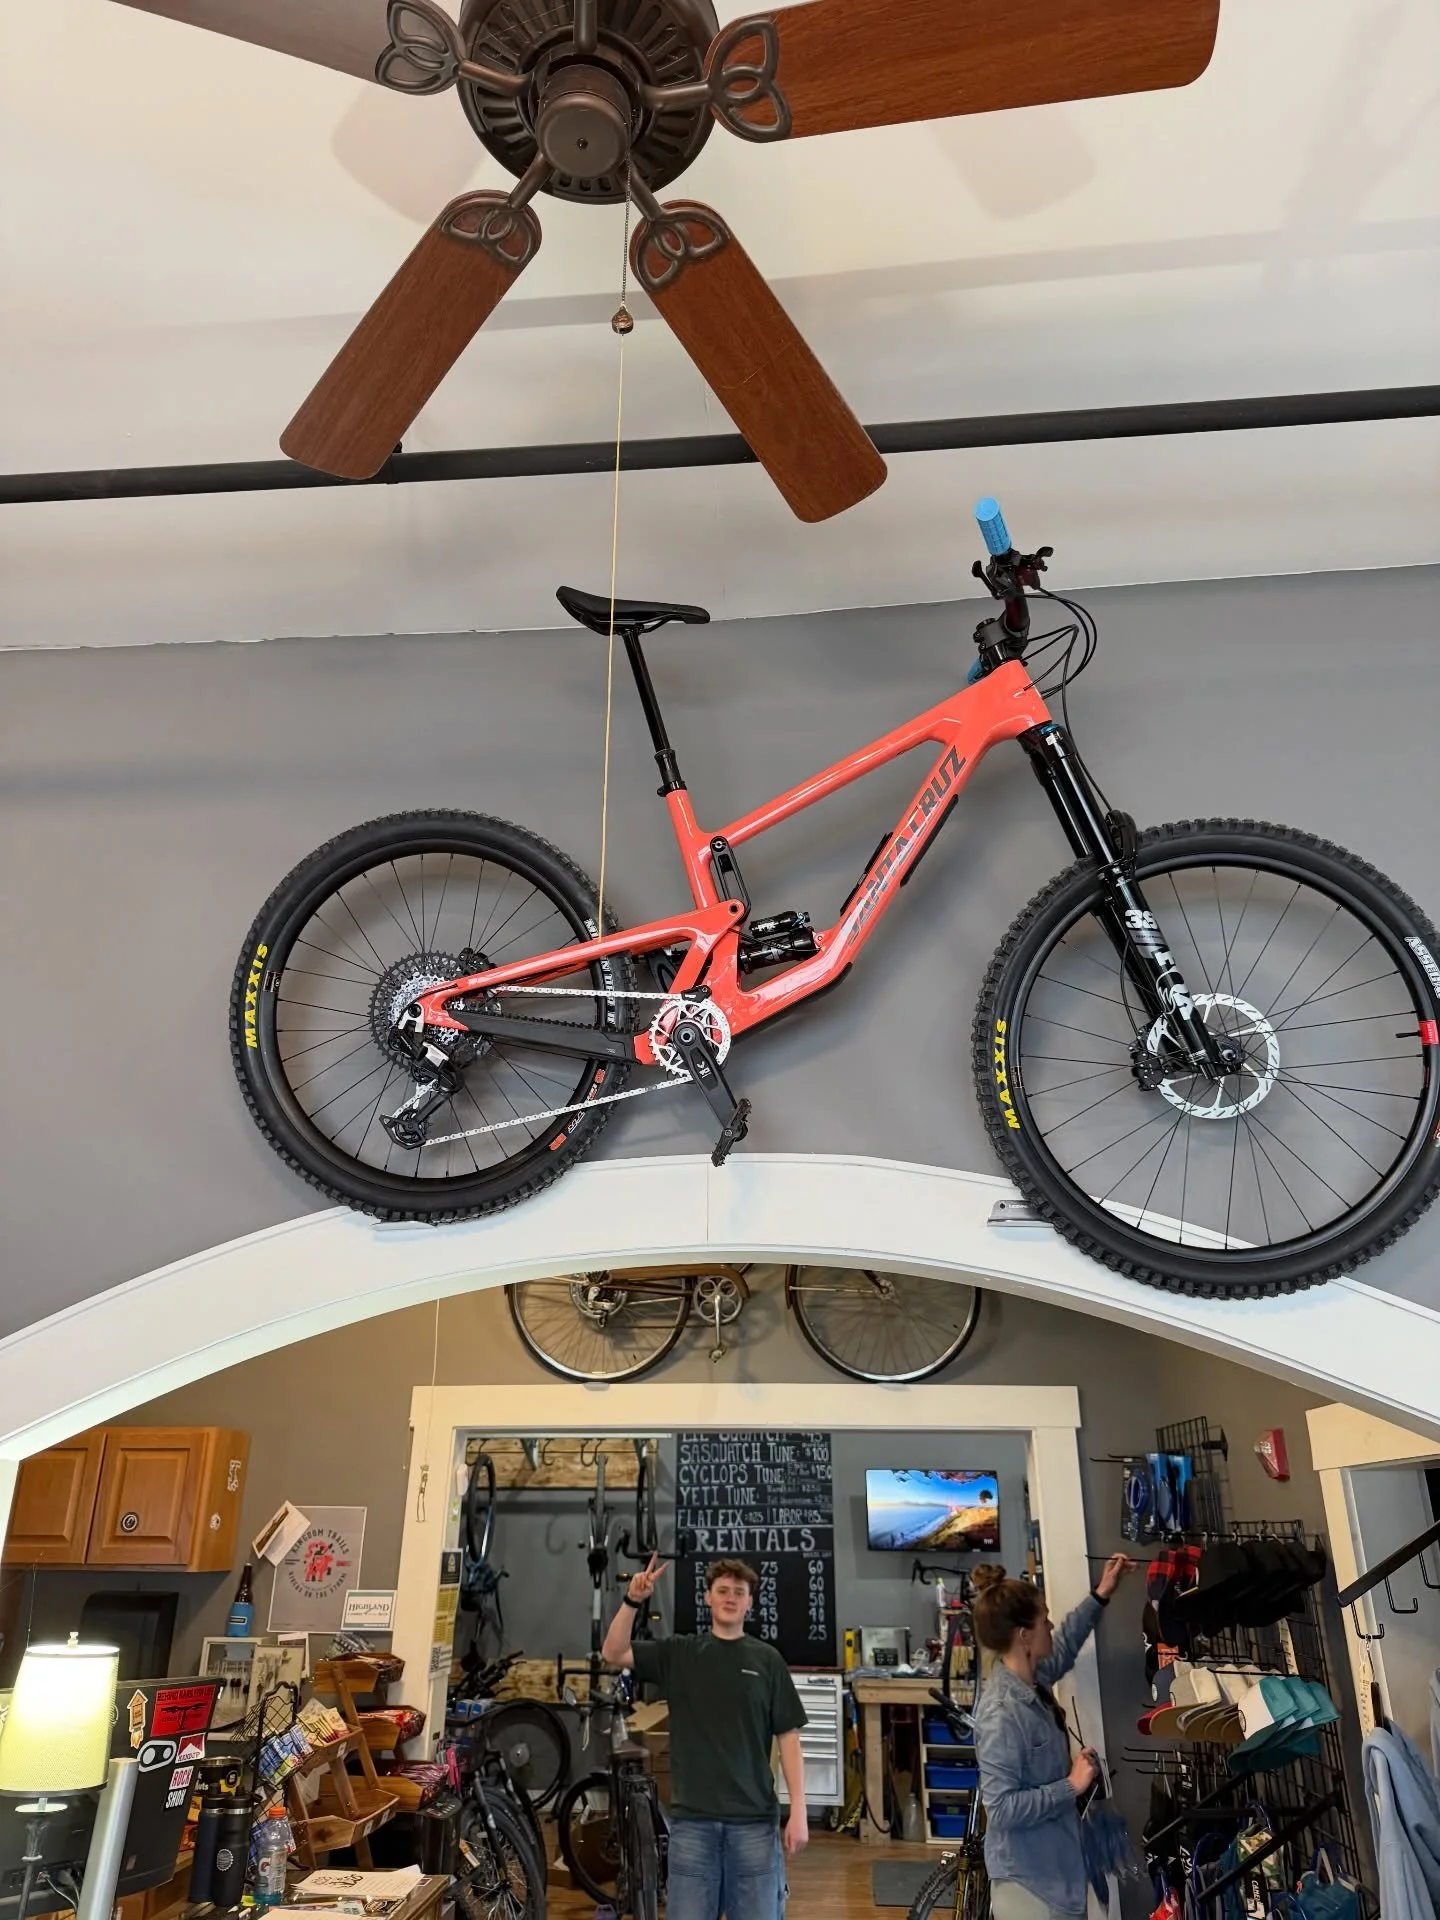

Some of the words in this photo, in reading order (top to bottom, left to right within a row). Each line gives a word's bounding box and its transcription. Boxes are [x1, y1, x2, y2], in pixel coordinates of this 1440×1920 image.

[1125, 909, 1158, 929] 38
[245, 943, 268, 1049] MAXXIS
[994, 1018, 1021, 1129] MAXXIS
[680, 1443, 762, 1464] SASQUATCH
[679, 1464, 749, 1484] CYCLOPS
[680, 1485, 719, 1506] YETI
[327, 1529, 350, 1555] TRAILS
[695, 1528, 816, 1552] RENTALS
[760, 1561, 779, 1575] 75
[808, 1560, 824, 1575] 60
[759, 1577, 777, 1591] 75
[808, 1576, 825, 1591] 60
[348, 1603, 390, 1612] HIGHLAND
[759, 1592, 779, 1607] 65
[809, 1592, 825, 1607] 50
[759, 1607, 779, 1622] 45
[808, 1608, 825, 1622] 40
[760, 1625, 778, 1640] 30
[808, 1624, 828, 1640] 25
[171, 1768, 193, 1788] ROCK
